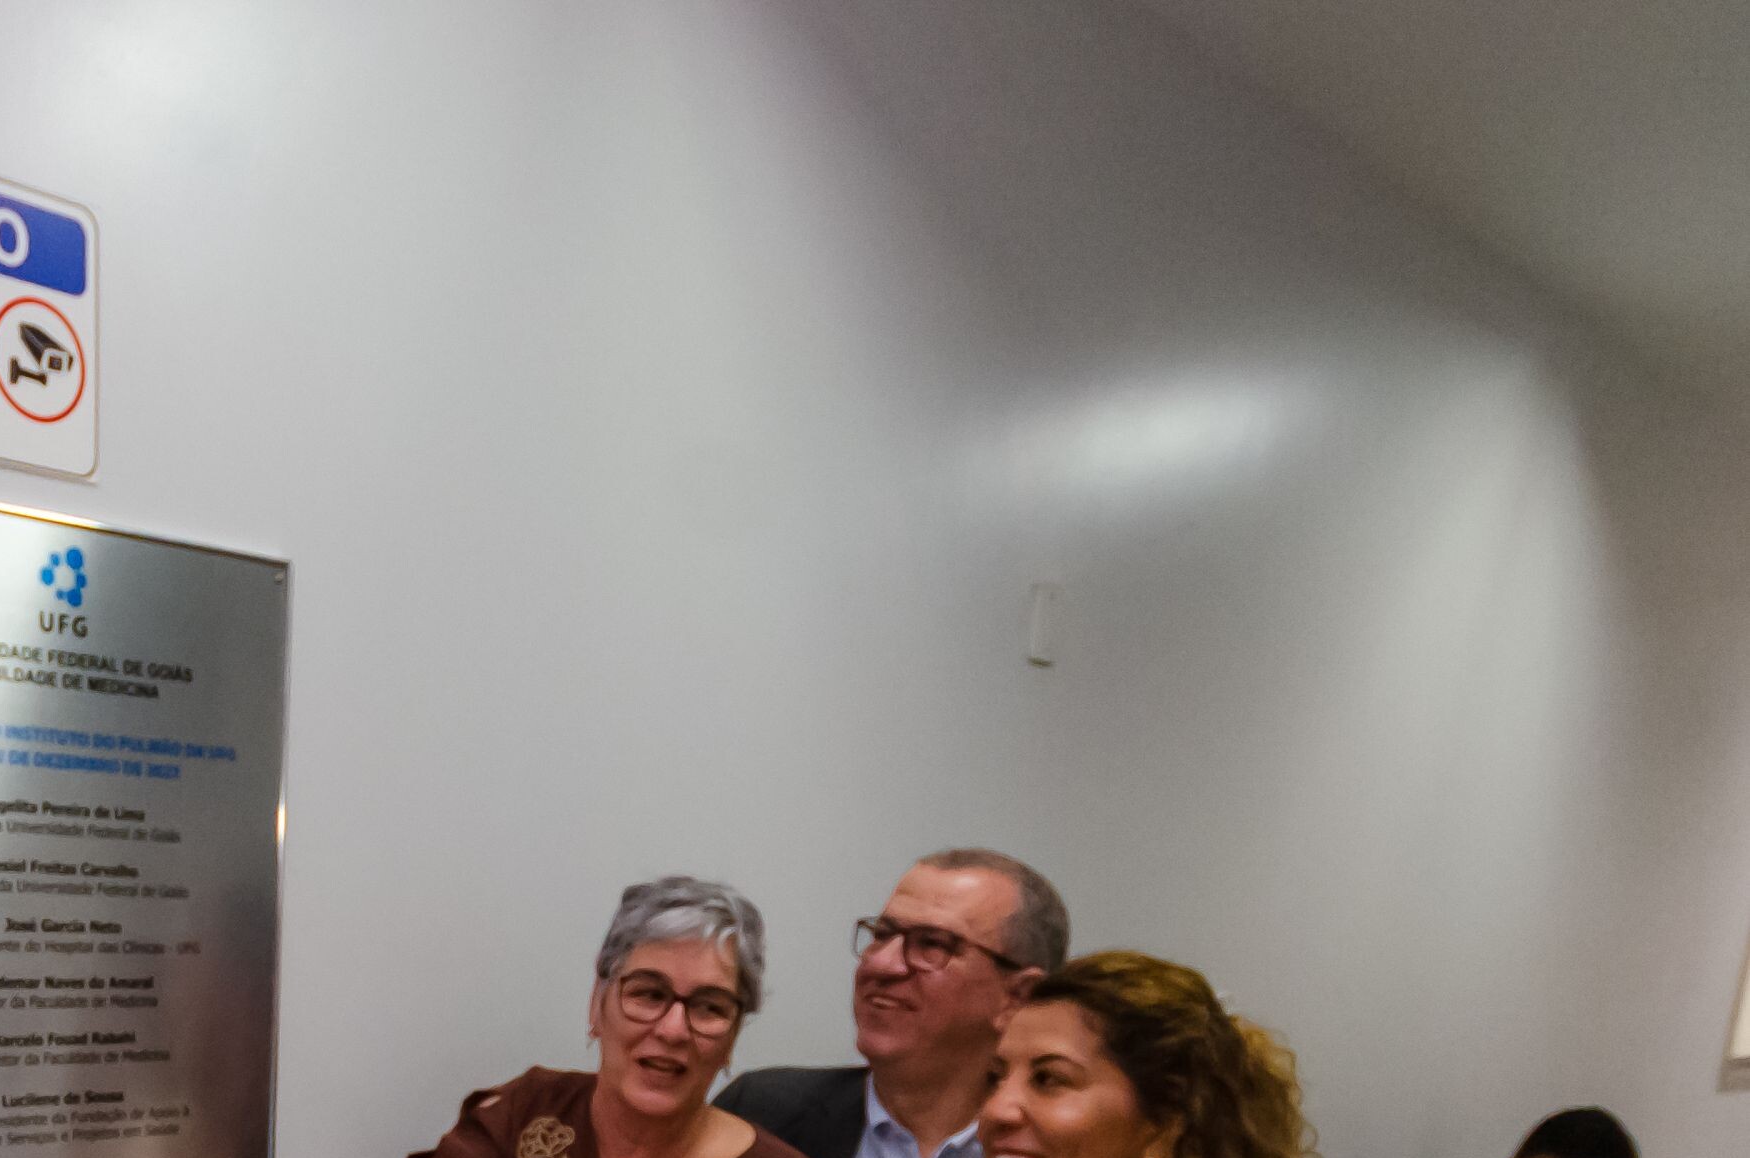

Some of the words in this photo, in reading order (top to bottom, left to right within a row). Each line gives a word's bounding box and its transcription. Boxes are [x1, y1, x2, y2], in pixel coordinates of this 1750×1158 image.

[39, 611, 88, 638] UFG
[48, 649, 119, 674] FEDERAL
[122, 659, 144, 679] DE
[62, 673, 83, 690] DE
[87, 676, 159, 699] MEDICINA
[4, 723, 91, 747] INSTITUTO
